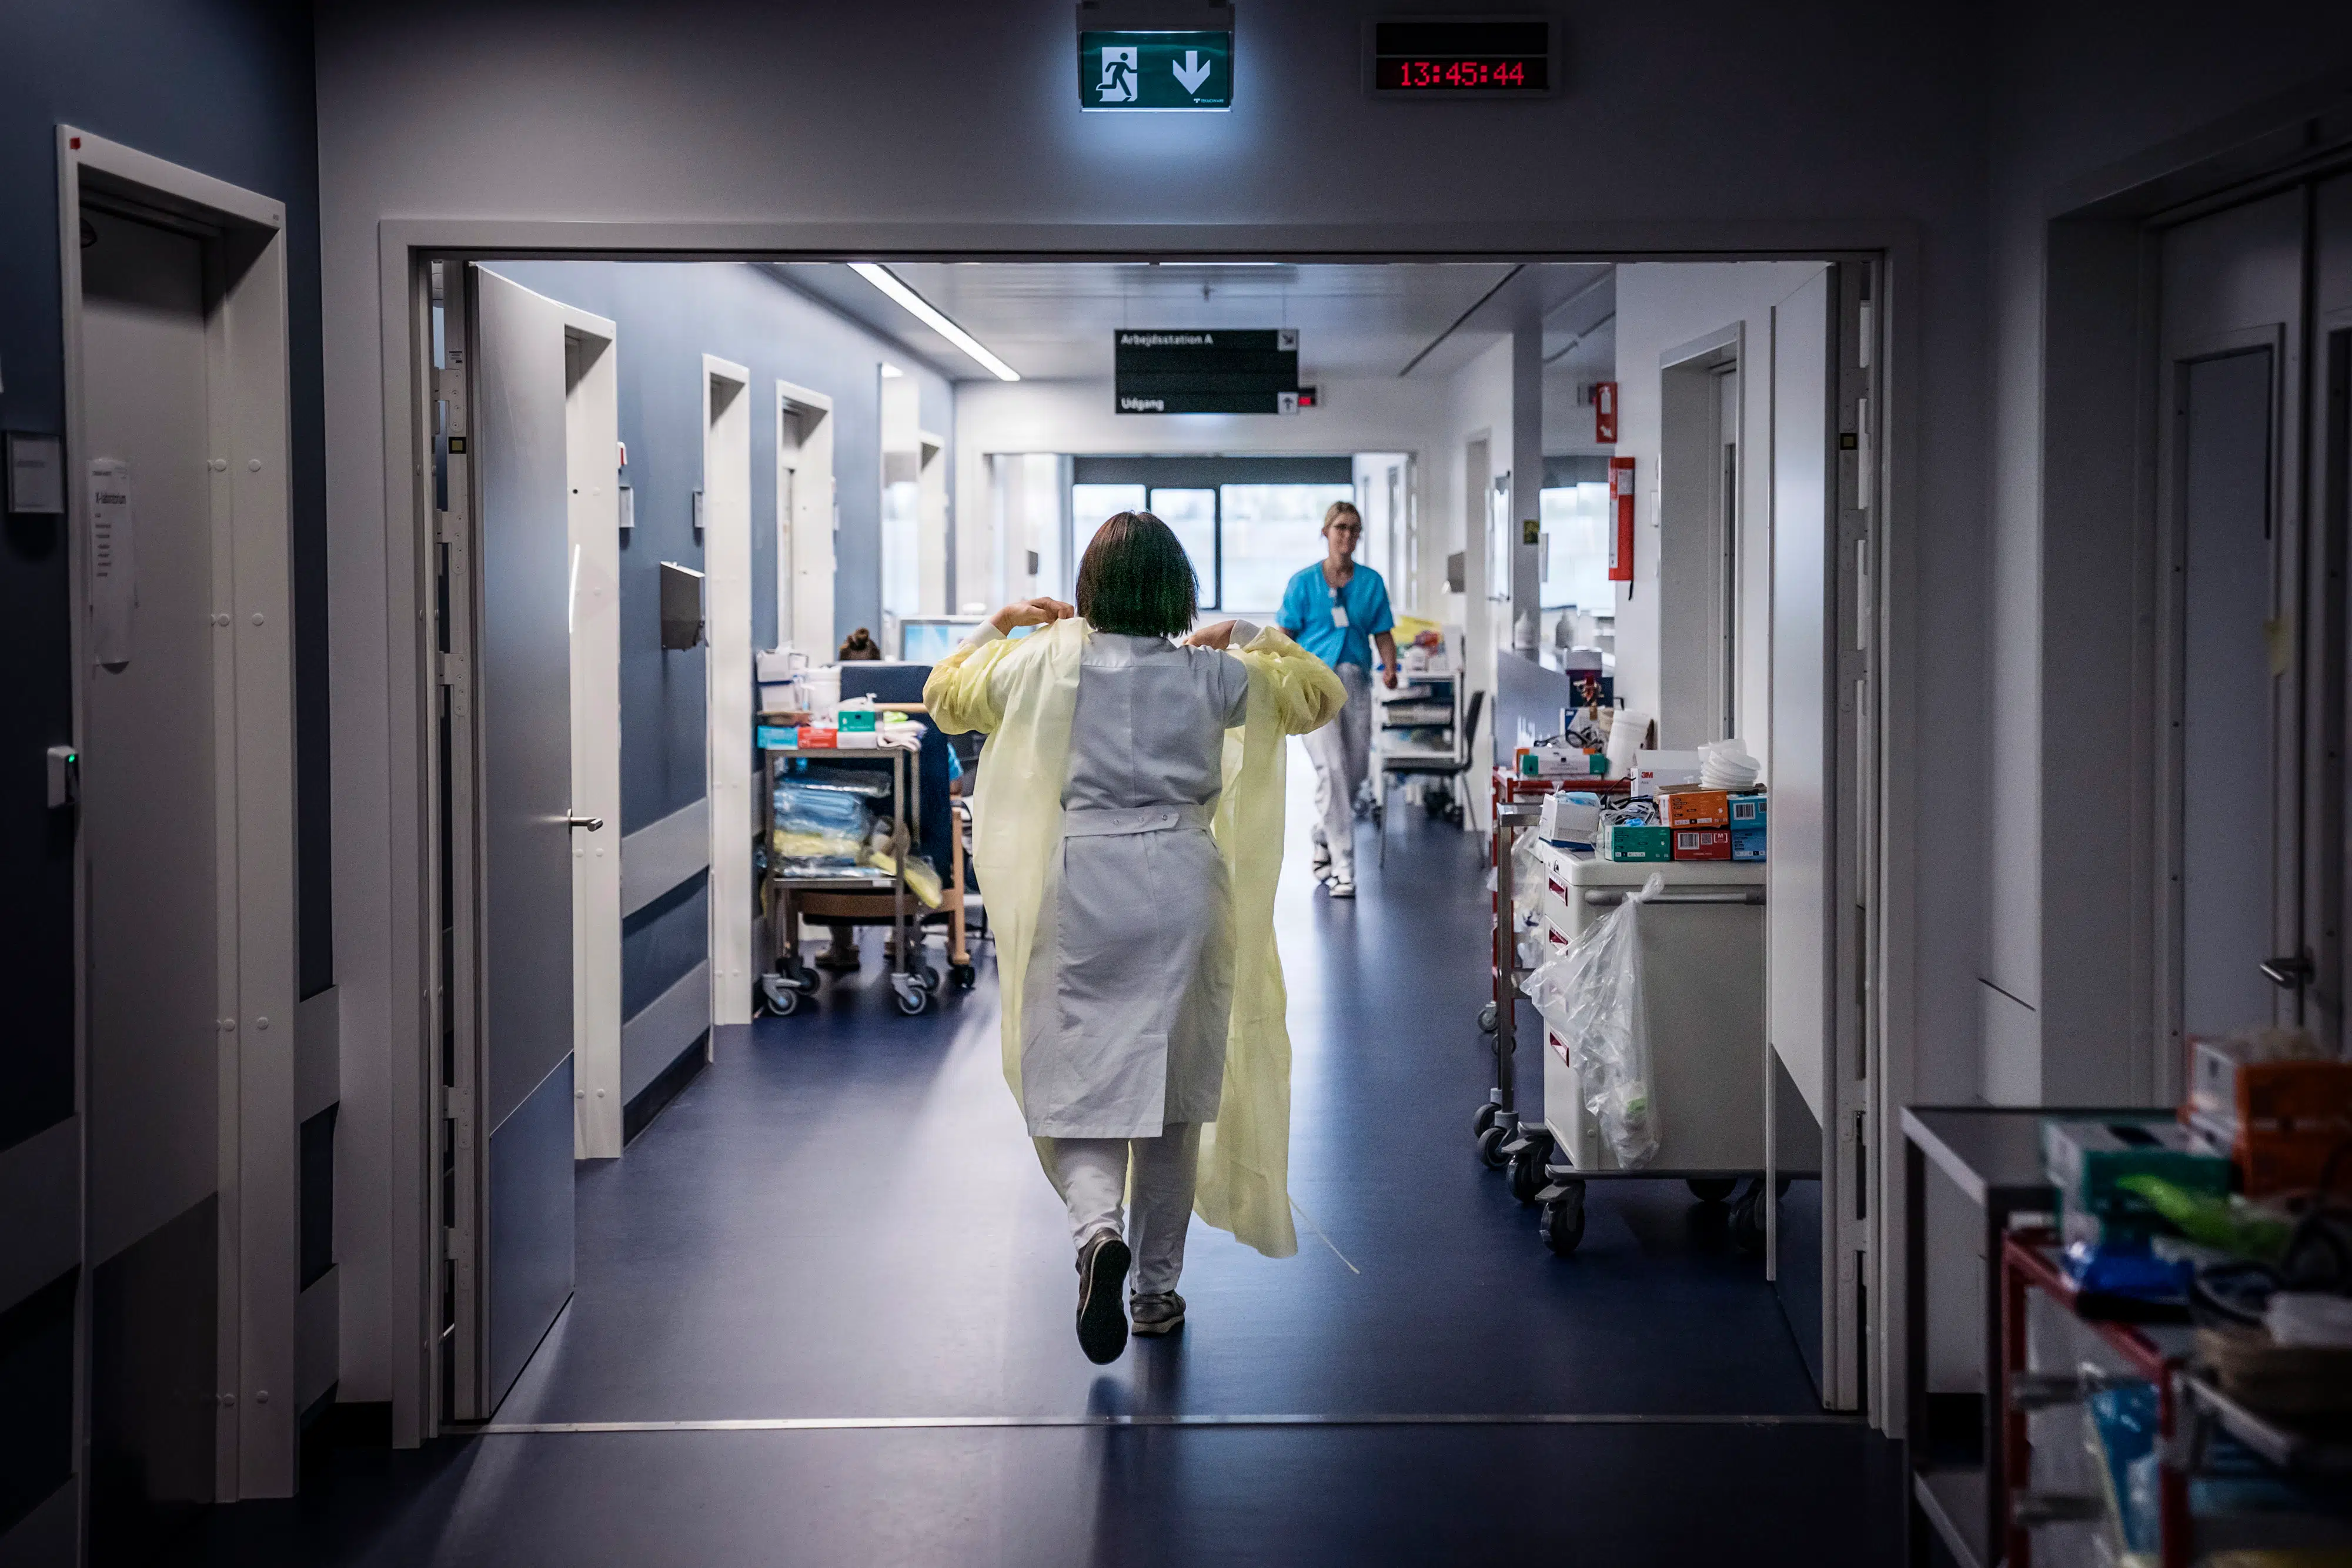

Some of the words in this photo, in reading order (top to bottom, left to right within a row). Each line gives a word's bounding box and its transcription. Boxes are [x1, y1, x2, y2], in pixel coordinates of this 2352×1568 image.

[1401, 61, 1525, 86] 13:45:44
[1120, 333, 1203, 347] Arbejdsstation
[1204, 333, 1214, 345] A
[1121, 397, 1165, 412] Udgang
